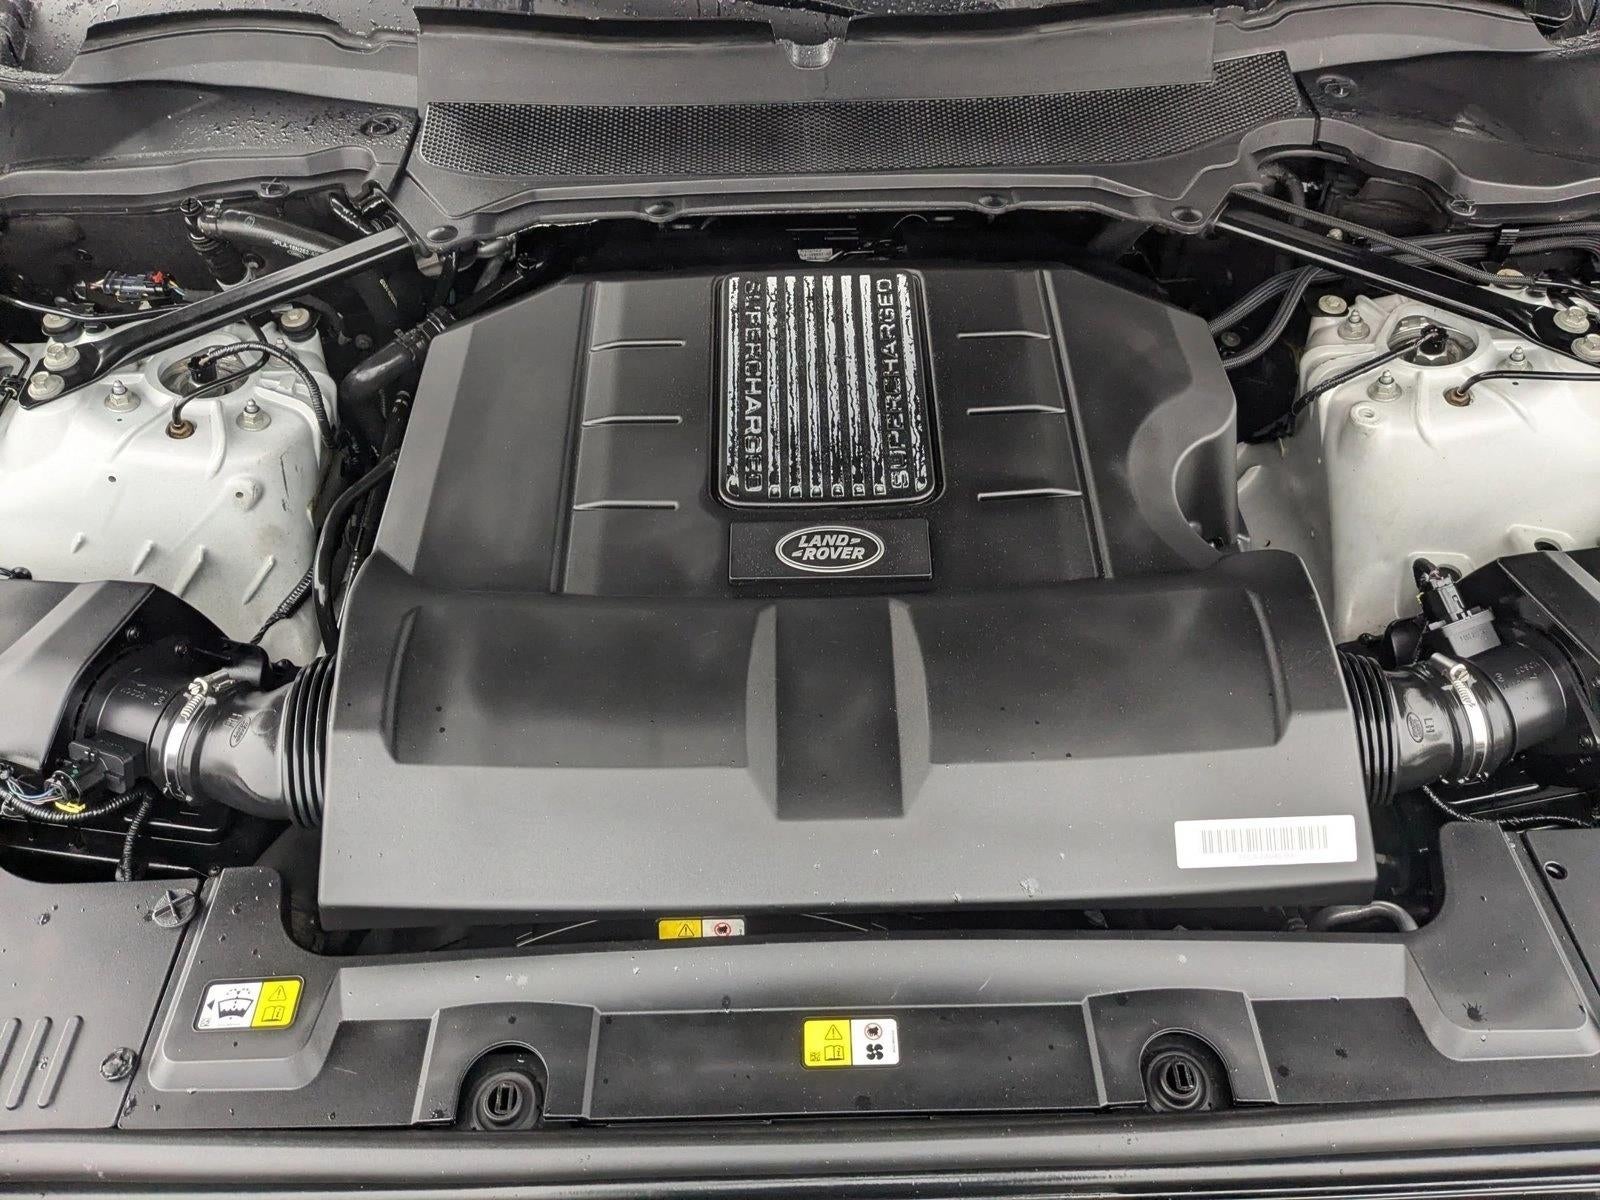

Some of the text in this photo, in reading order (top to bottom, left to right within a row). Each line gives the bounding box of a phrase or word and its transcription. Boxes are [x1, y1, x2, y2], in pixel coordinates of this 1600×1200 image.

[744, 280, 763, 492] SUPERCHARGED
[876, 278, 910, 489] SUPERCHARGED
[798, 534, 850, 548] LAND
[802, 547, 866, 561] ROVER
